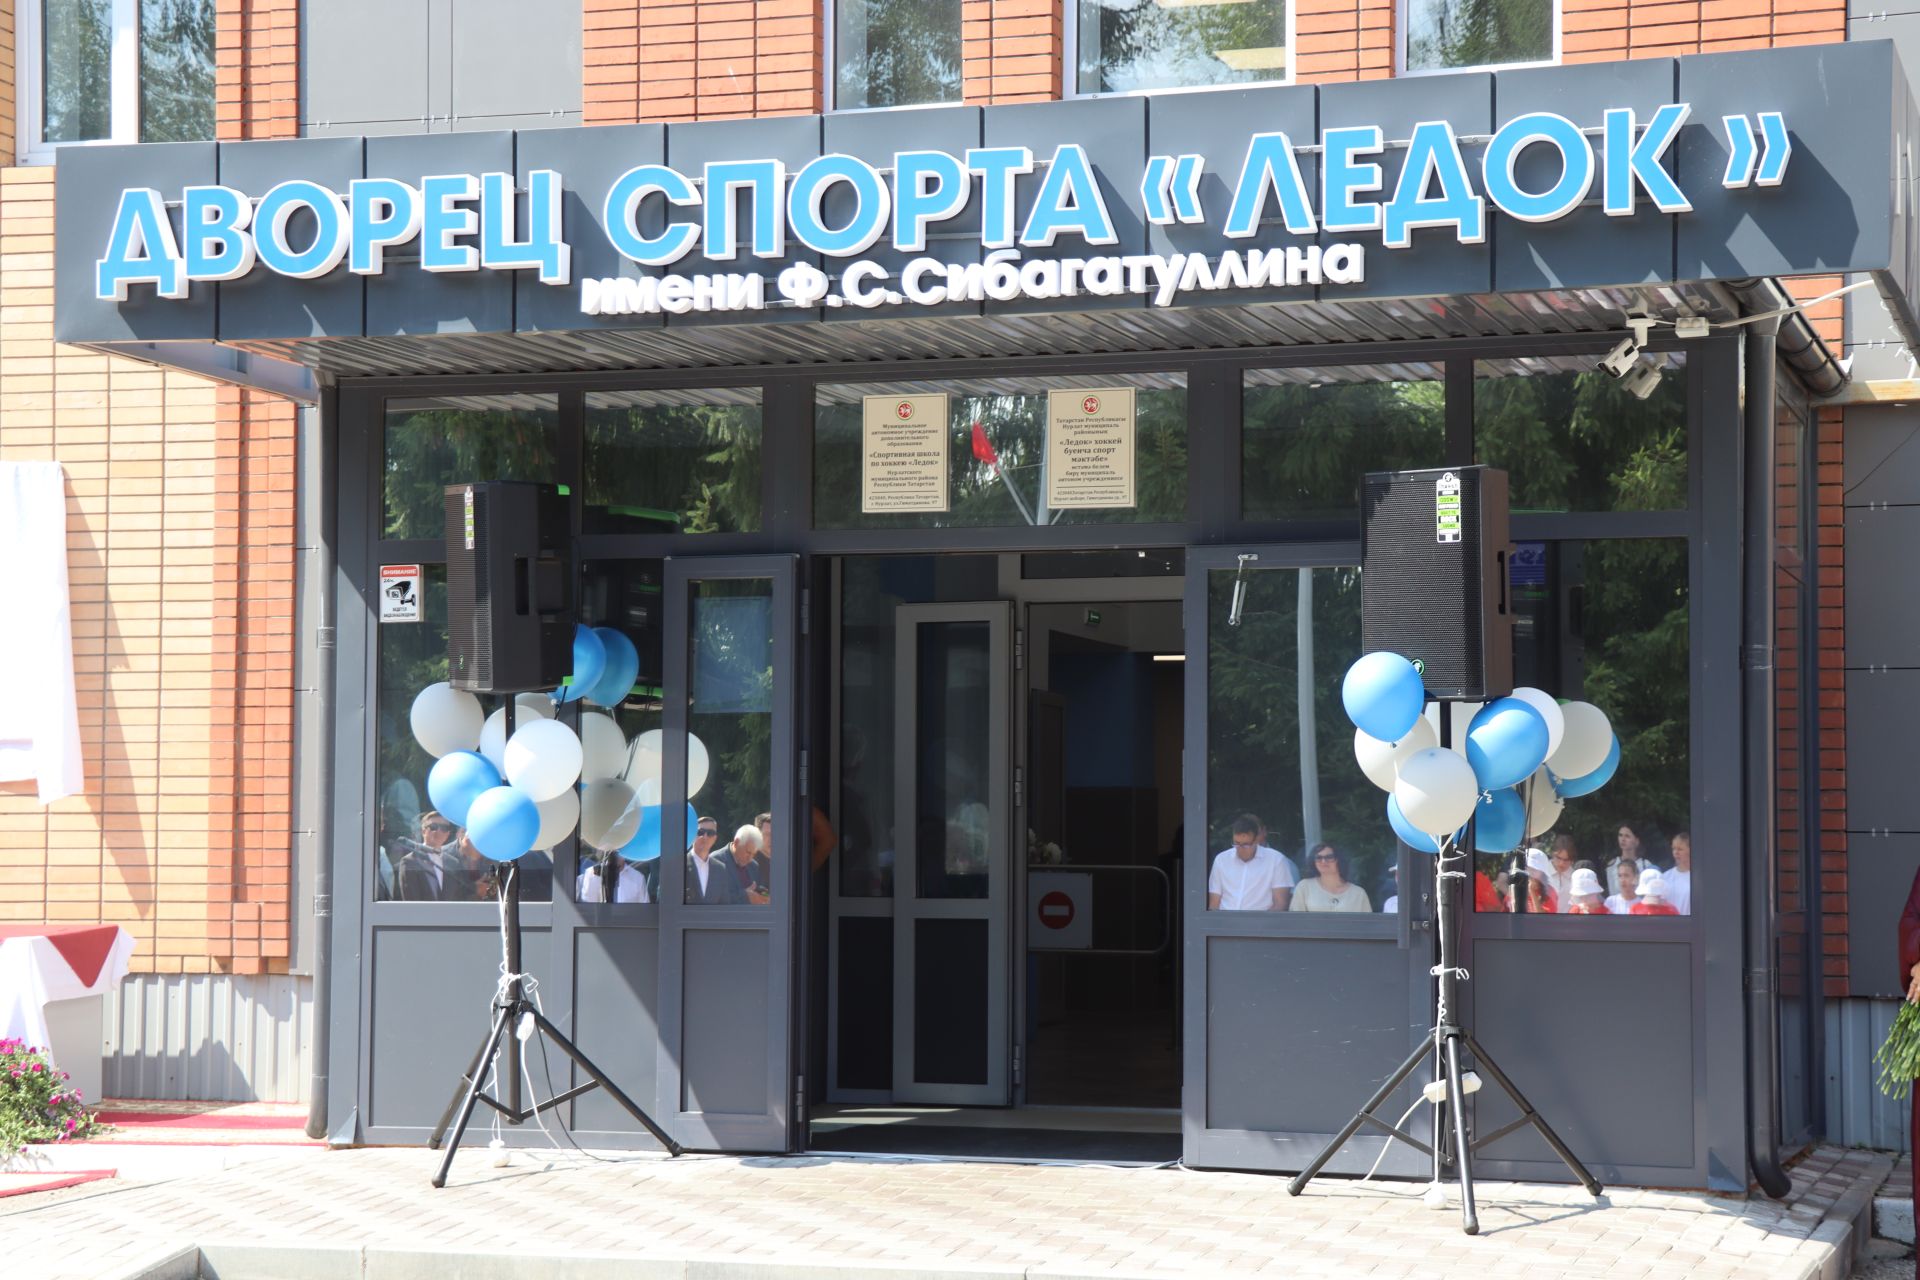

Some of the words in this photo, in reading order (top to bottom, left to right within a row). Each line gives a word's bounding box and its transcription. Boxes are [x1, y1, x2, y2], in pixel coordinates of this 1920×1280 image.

[96, 169, 571, 300] ДВОРЕЦ
[604, 144, 1119, 266] СПОРТА
[580, 272, 766, 315] имени
[1059, 438, 1093, 447] «Ледок»
[1094, 437, 1122, 446] хоккей
[869, 451, 915, 460] «Спортивная
[916, 450, 940, 458] школа
[1063, 447, 1092, 456] буенча
[1092, 446, 1117, 455] спорт
[870, 460, 881, 468] по
[908, 458, 939, 467] «Ледок»
